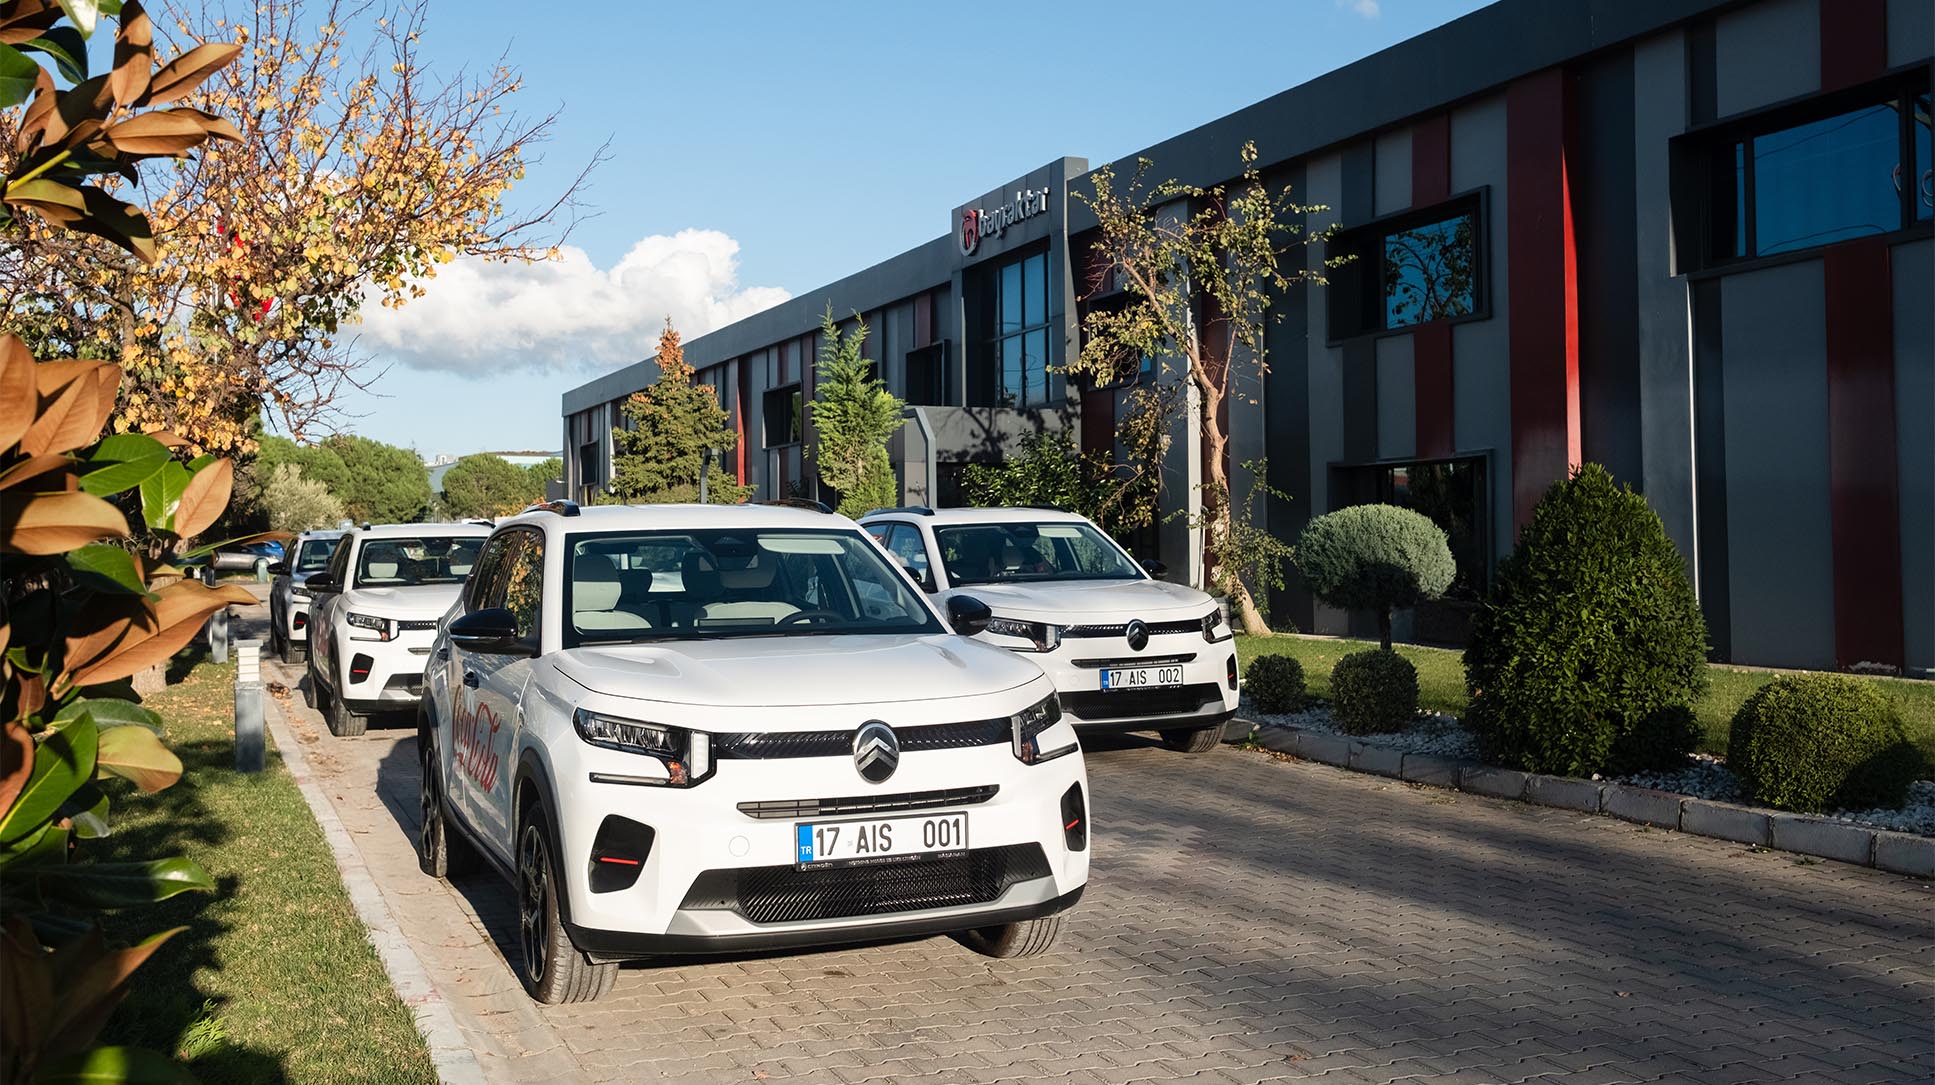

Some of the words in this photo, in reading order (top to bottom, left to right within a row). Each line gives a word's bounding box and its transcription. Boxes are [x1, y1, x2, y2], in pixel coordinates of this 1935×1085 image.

[1110, 672, 1121, 686] 17
[1129, 670, 1147, 686] AIS
[1158, 668, 1179, 684] 002
[816, 826, 840, 857] 17
[856, 823, 892, 854] AIS
[923, 817, 961, 849] 001
[800, 845, 813, 856] TR
